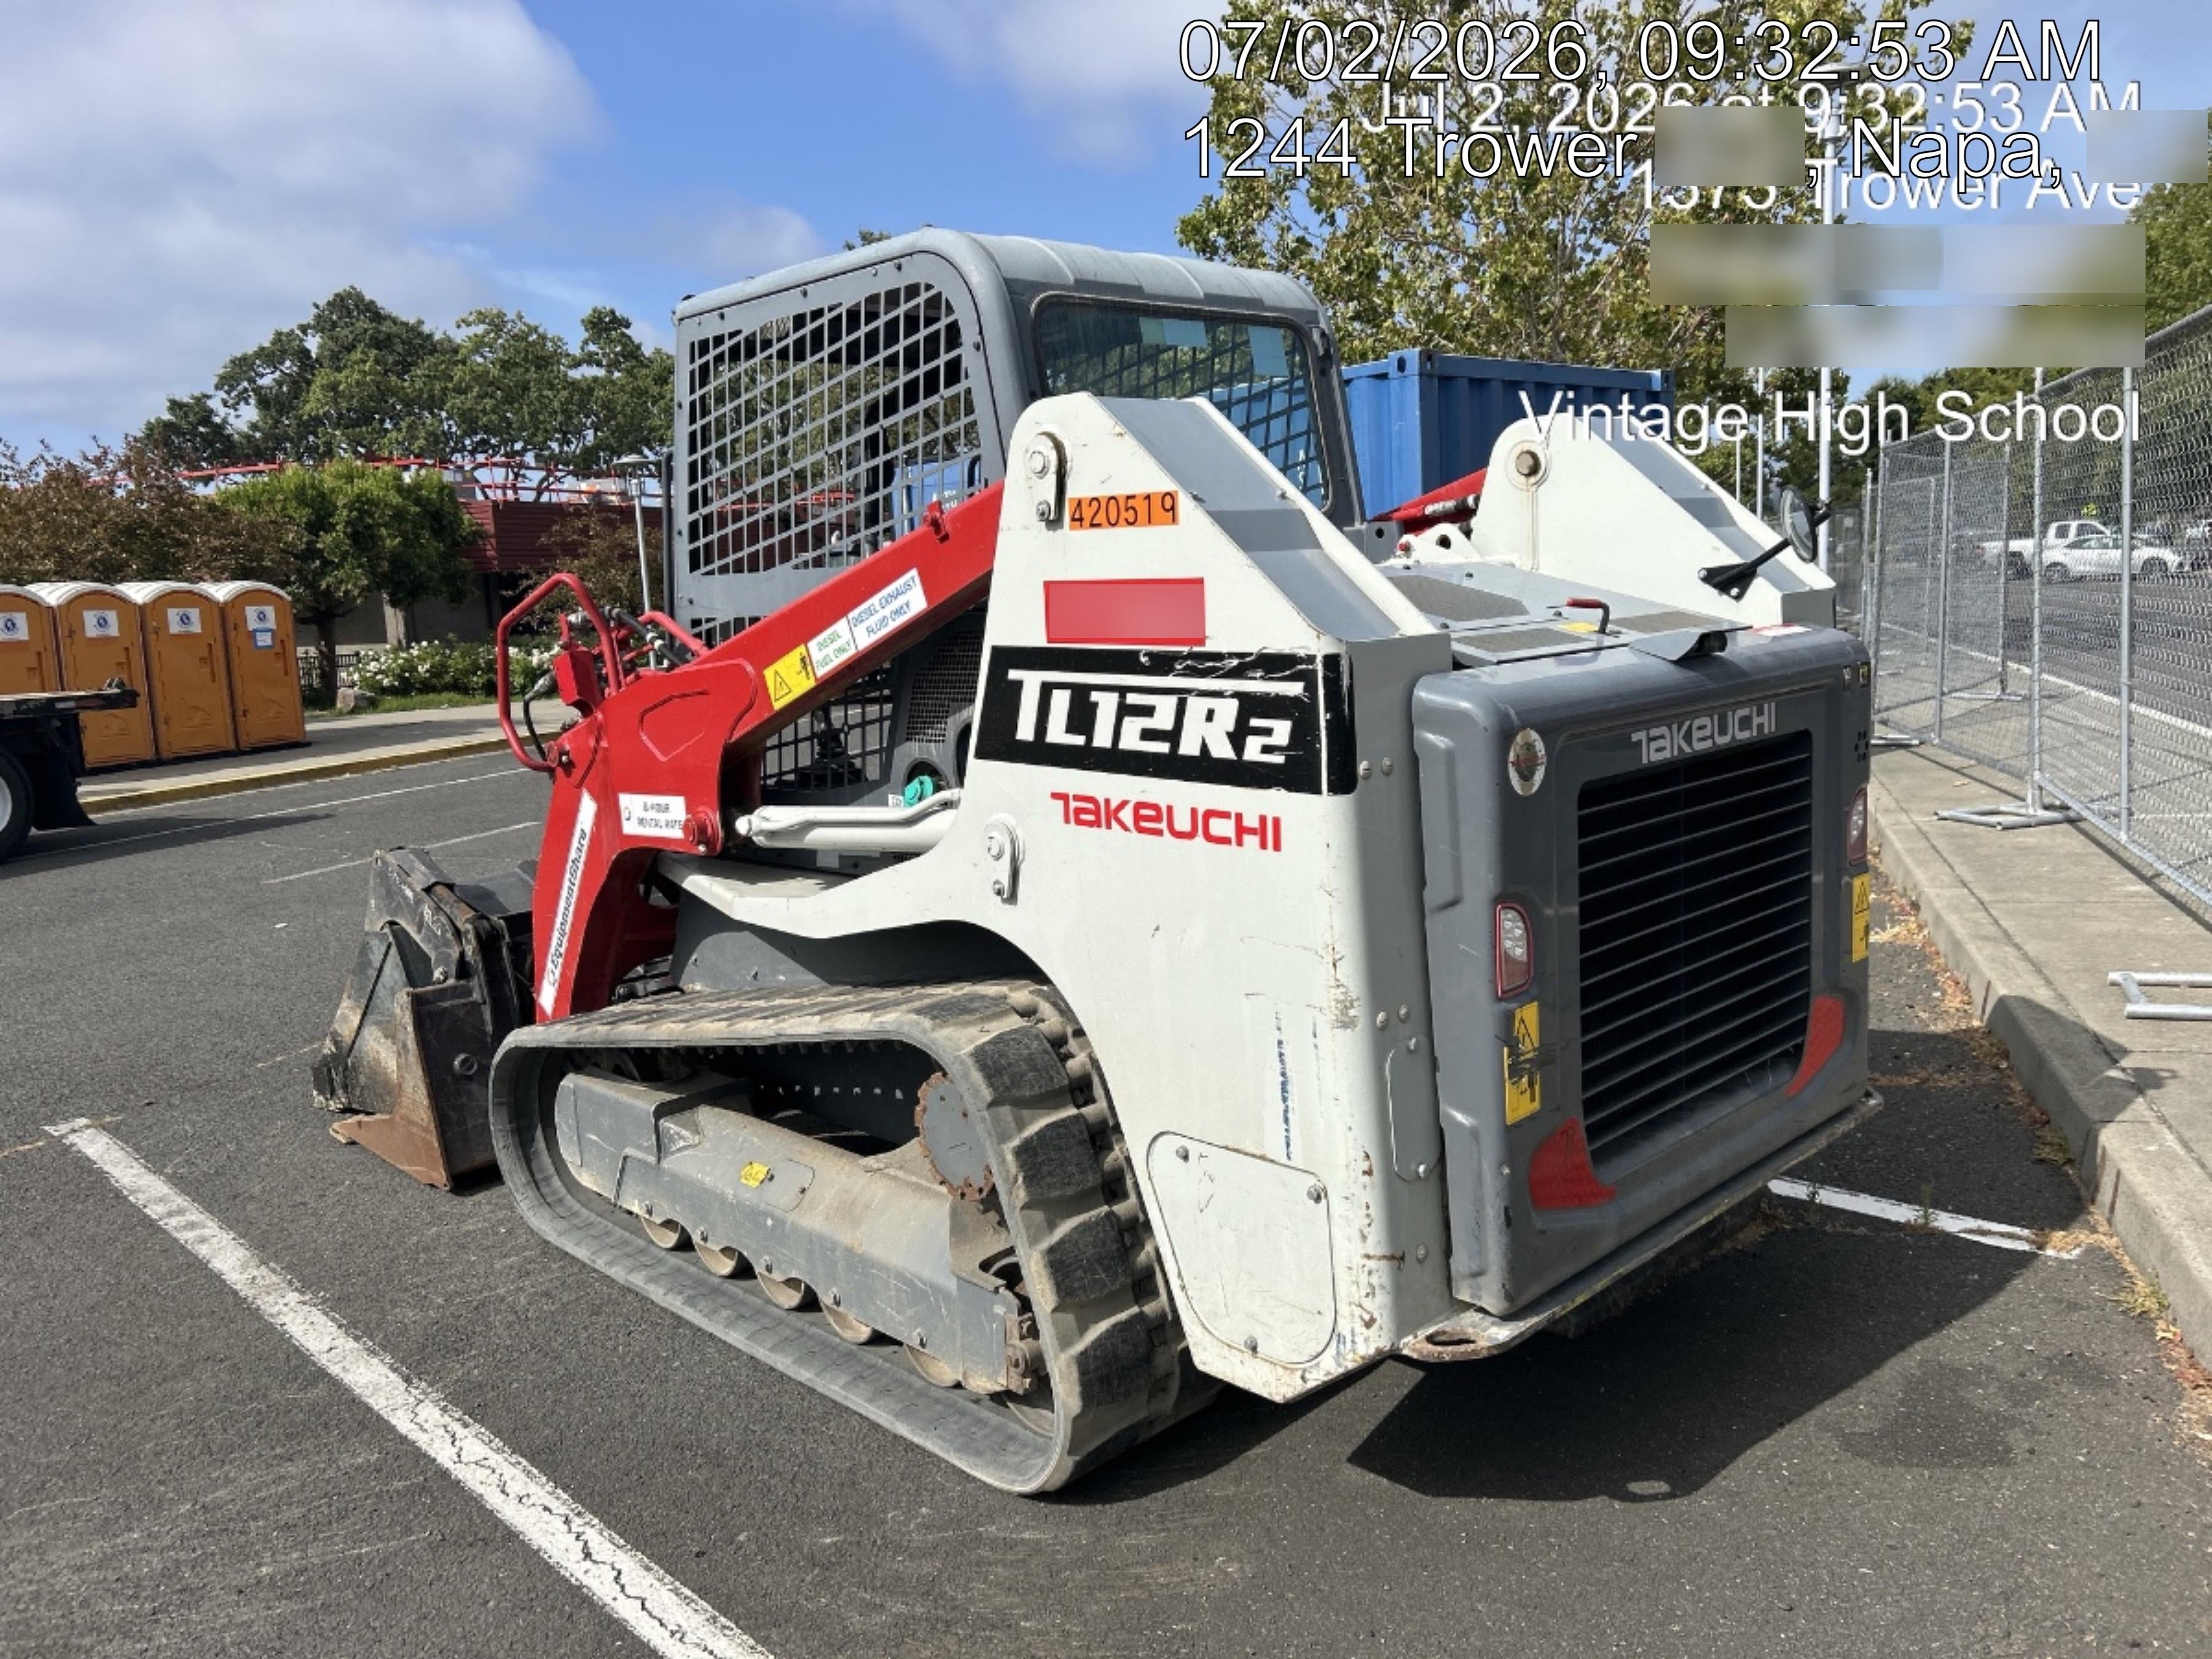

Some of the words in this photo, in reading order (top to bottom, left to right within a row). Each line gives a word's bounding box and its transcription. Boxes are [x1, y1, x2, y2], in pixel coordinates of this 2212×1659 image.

[1071, 492, 1175, 528] 420519
[852, 603, 879, 627] DIESEL
[879, 575, 916, 608] EXHAUST
